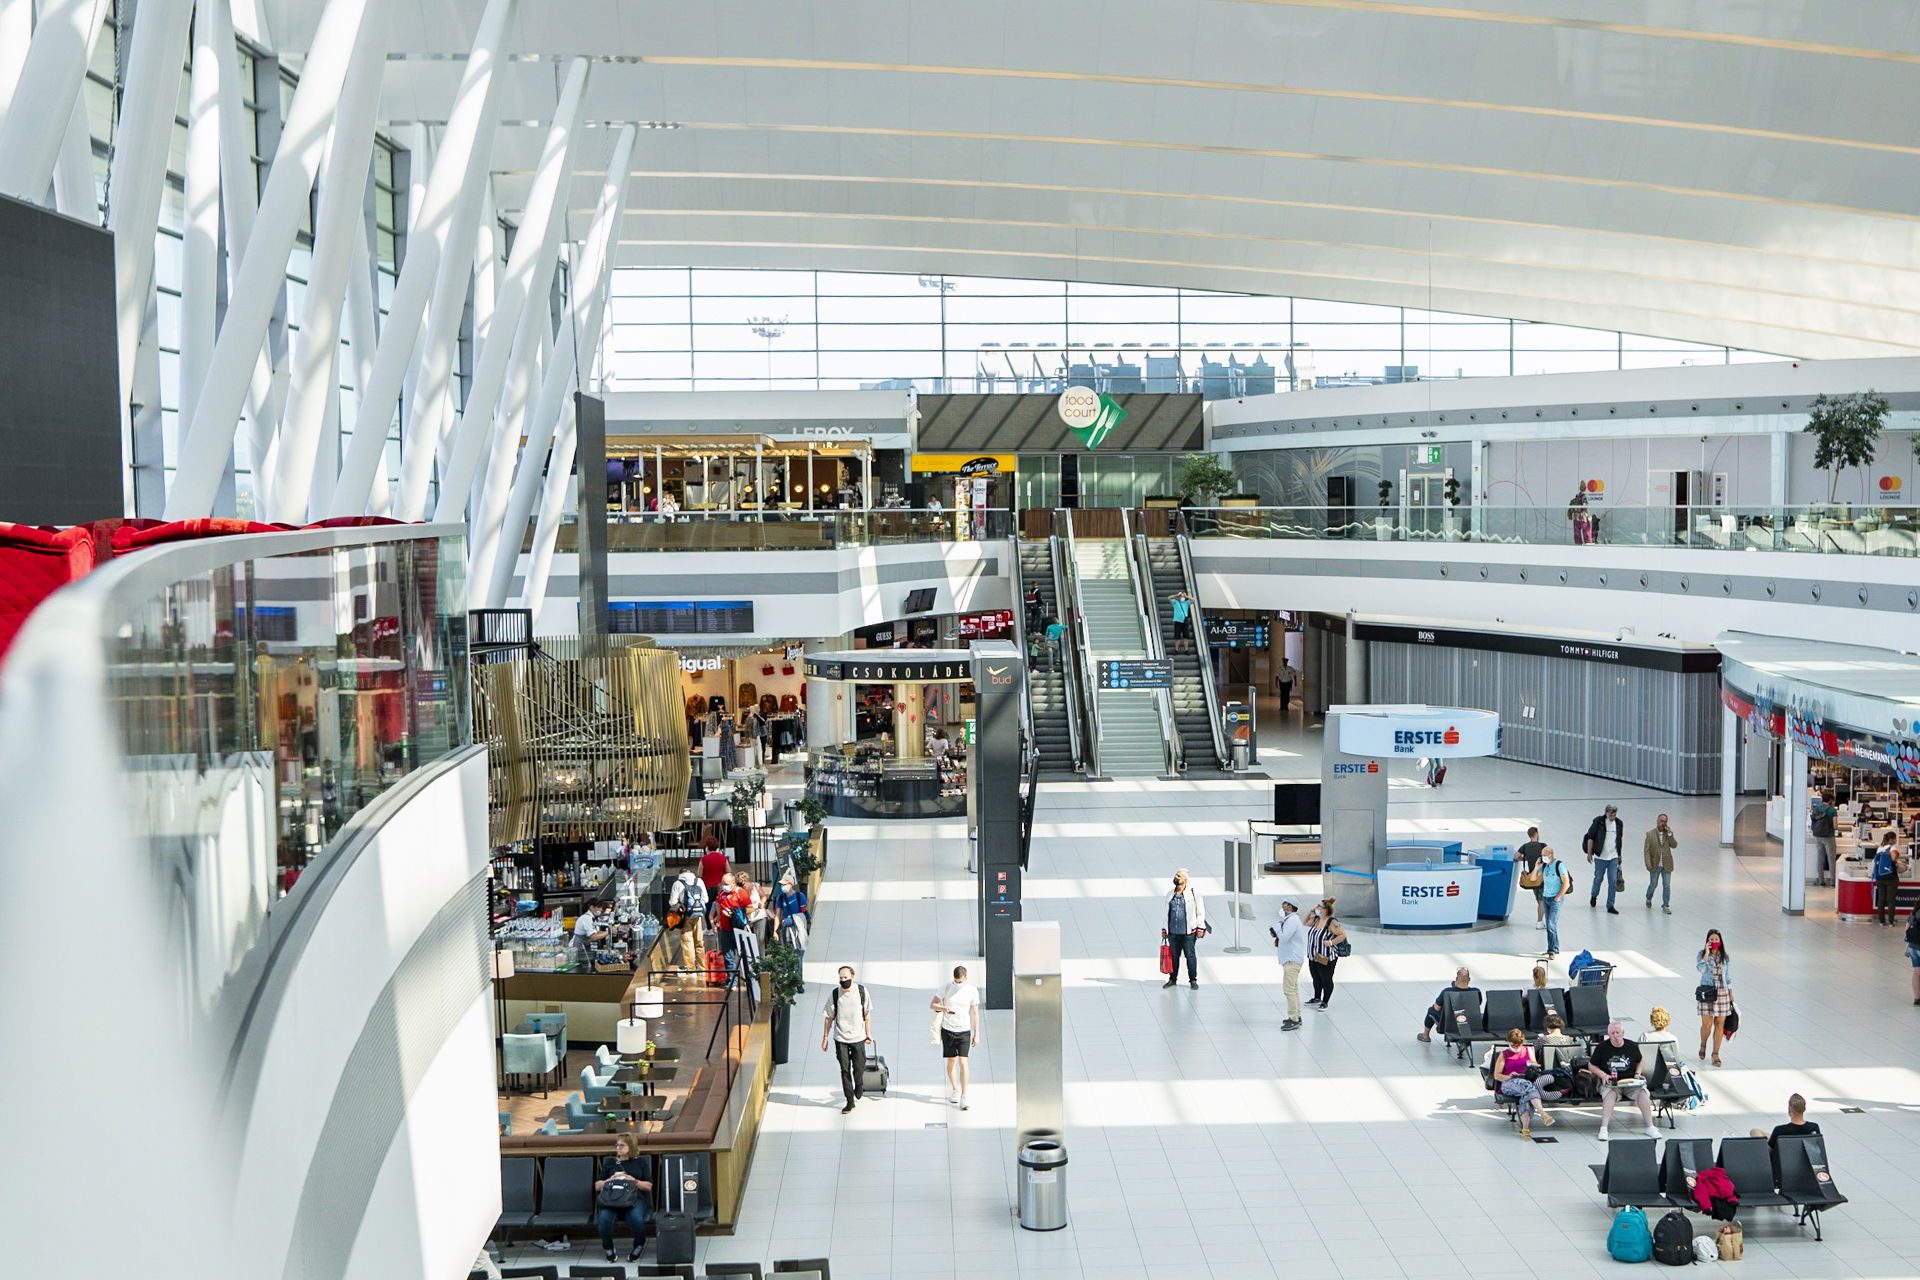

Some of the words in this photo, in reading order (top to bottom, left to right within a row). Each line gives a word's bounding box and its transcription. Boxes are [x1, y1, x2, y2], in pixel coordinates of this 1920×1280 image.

[1065, 395, 1093, 405] food
[1064, 408, 1096, 417] court
[876, 631, 892, 642] GUESS
[1418, 631, 1435, 640] BOSS
[1560, 645, 1584, 655] TOMMY
[1592, 649, 1619, 660] HILFIGER
[852, 664, 964, 679] CSOKOLÁDÉ
[992, 674, 1012, 685] bud
[1394, 731, 1442, 744] ERSTE
[1394, 745, 1414, 753] Bank
[1855, 744, 1890, 764] HEINEMANN
[1334, 763, 1366, 774] ERSTE
[1402, 885, 1444, 898] ERSTE
